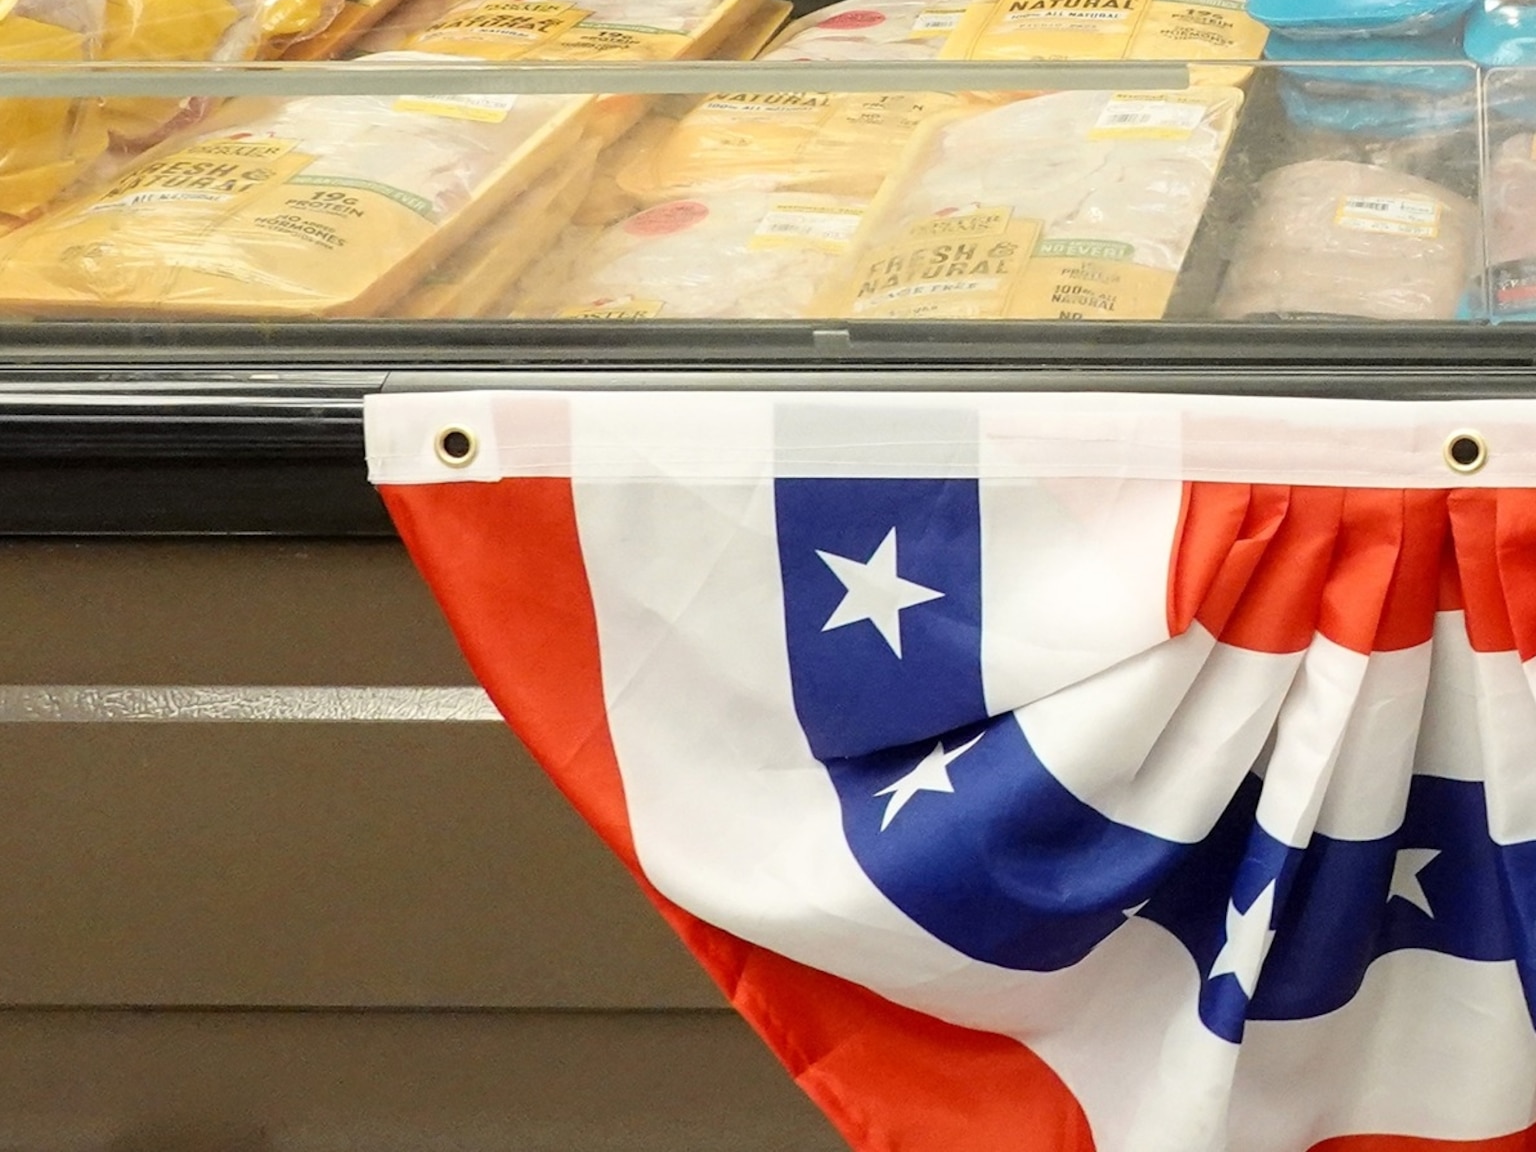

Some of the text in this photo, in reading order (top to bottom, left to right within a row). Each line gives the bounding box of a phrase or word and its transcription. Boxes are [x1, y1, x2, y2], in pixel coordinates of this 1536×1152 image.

[310, 190, 359, 206] 19G
[285, 199, 365, 218] PROTEIN
[254, 217, 347, 247] HORMONES
